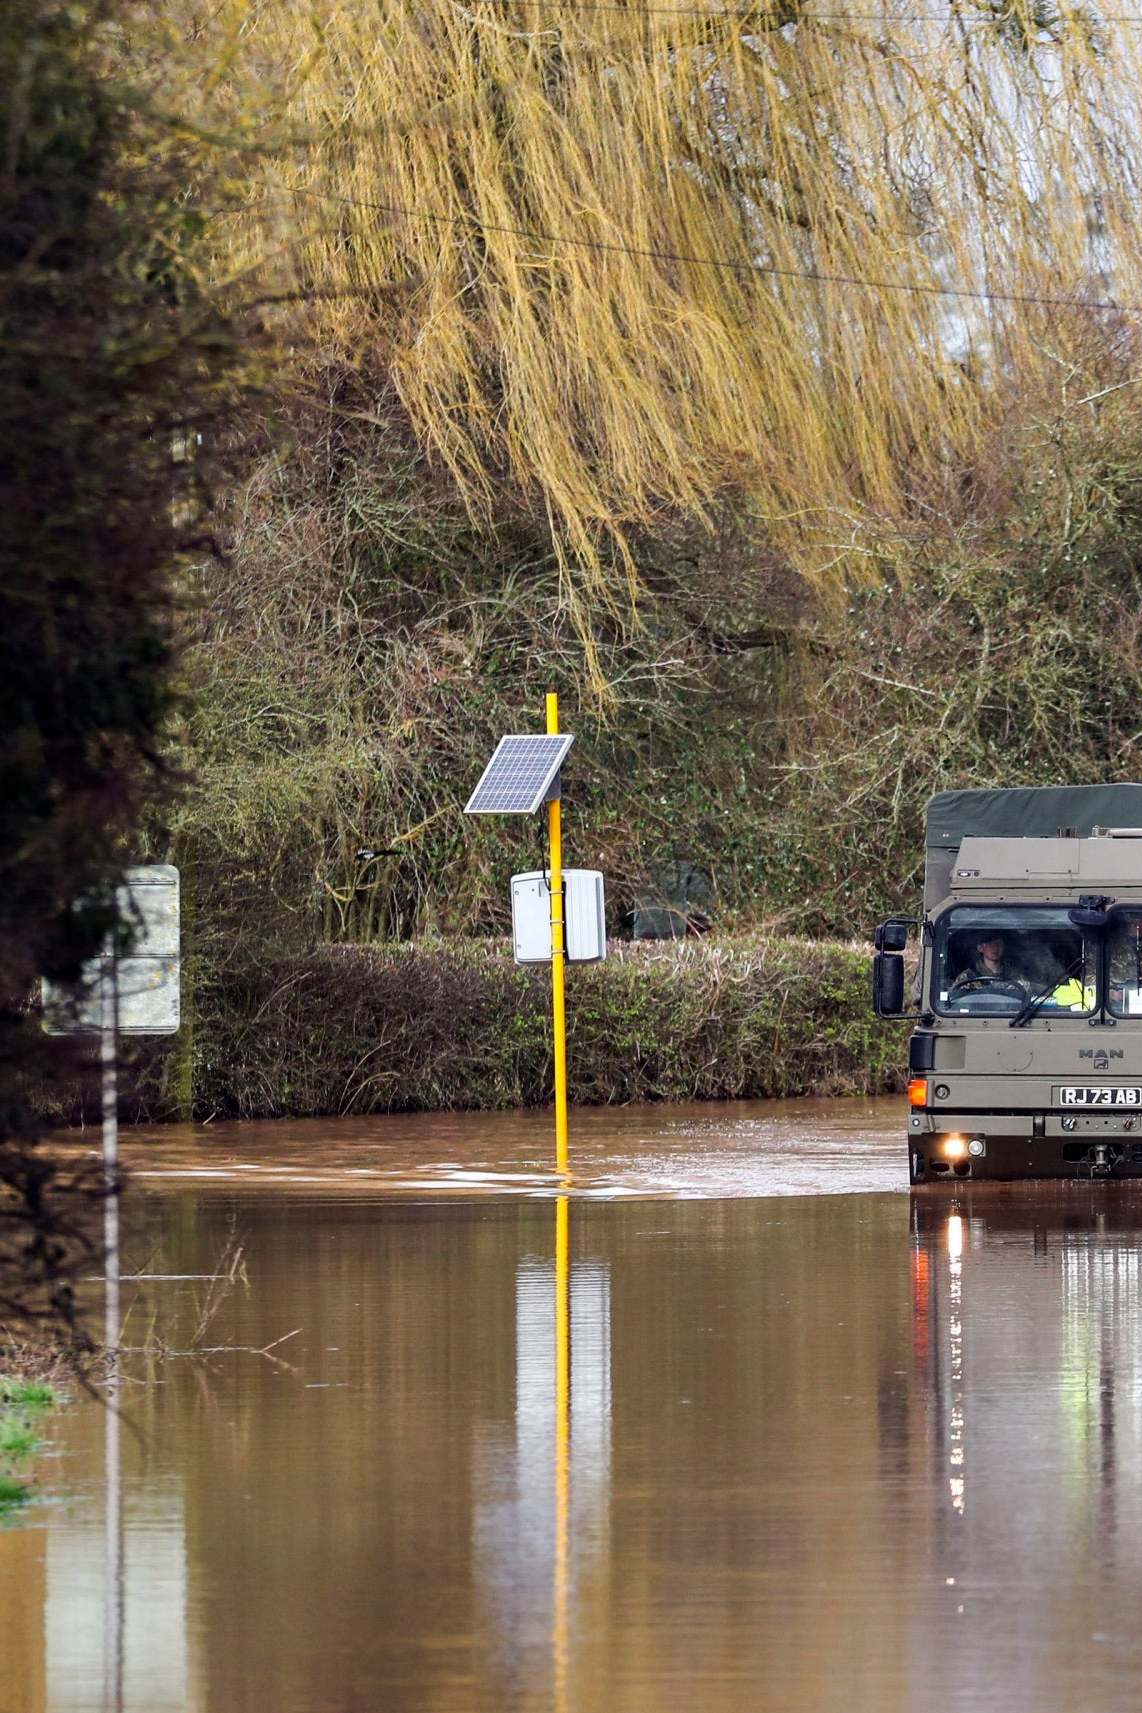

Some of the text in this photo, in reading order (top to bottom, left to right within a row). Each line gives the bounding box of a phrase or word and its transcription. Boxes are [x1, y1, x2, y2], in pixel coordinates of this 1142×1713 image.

[1079, 1049, 1124, 1059] MAN
[1065, 1089, 1137, 1104] RJ 73 AB
